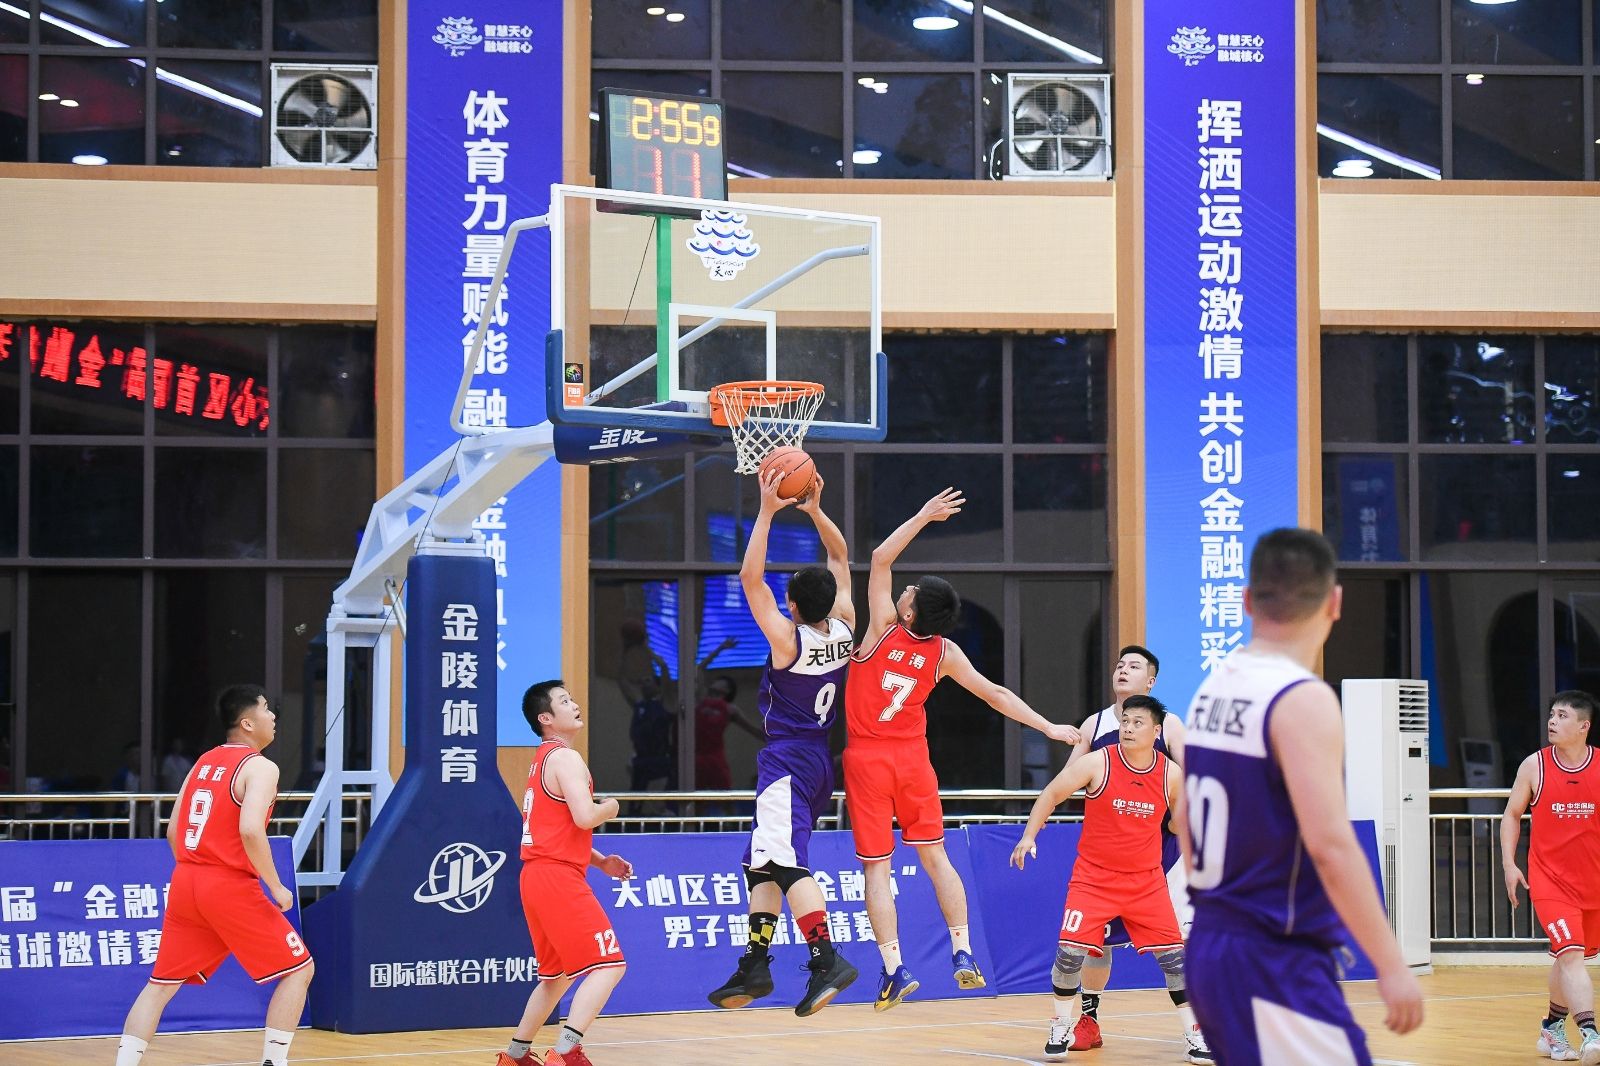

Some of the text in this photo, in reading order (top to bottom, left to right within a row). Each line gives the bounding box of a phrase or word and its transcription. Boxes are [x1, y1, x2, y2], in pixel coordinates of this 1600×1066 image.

[462, 90, 509, 375] 体育力量赋能
[1197, 98, 1245, 677] 挥洒运动激情 共创金融精彩
[441, 603, 480, 783] 金陵体育
[814, 682, 836, 727] 9
[878, 670, 918, 722] 7
[185, 789, 213, 850] 9
[0, 880, 169, 922] 届“金融
[1062, 908, 1084, 933] 10
[285, 930, 305, 957] 9
[594, 929, 620, 957] 12
[1547, 918, 1572, 943] 11
